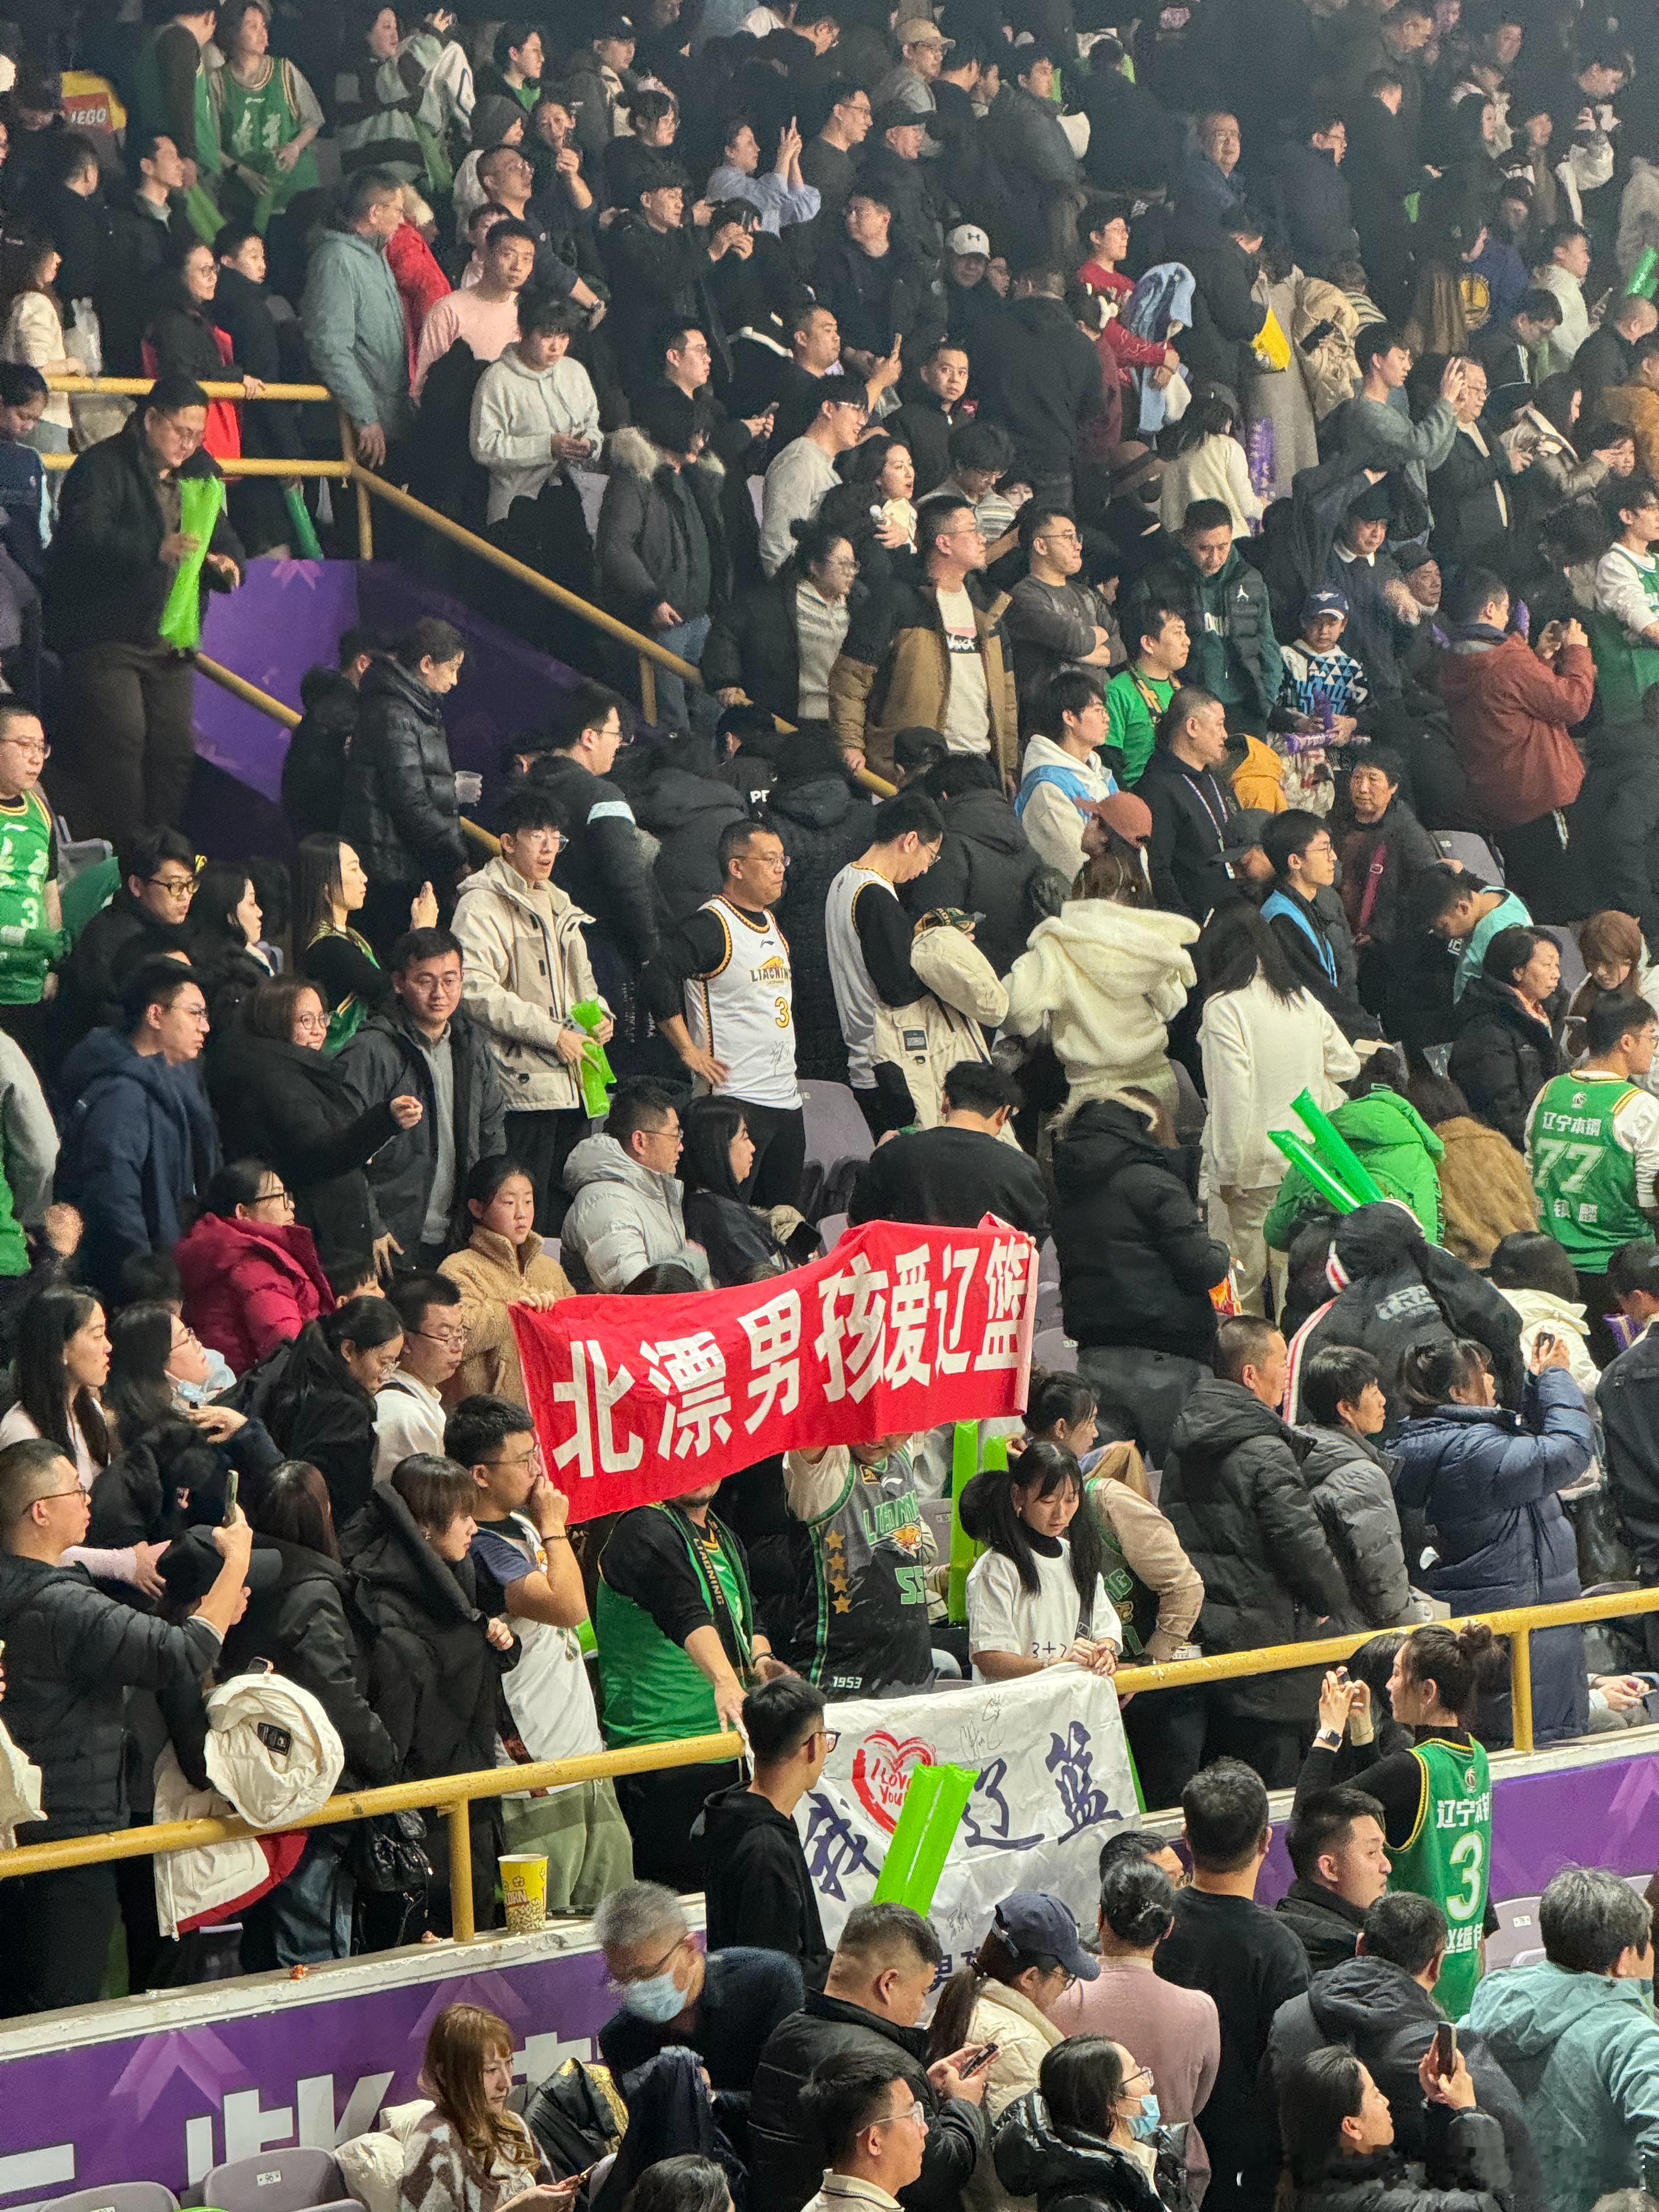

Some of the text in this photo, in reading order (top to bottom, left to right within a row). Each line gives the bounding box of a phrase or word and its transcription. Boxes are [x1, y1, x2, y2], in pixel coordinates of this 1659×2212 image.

[20, 898, 38, 930] 3
[775, 996, 789, 1028] 3
[1534, 1137, 1608, 1194] 77
[552, 1235, 1030, 1477] 北漂男孩爱辽篮
[693, 1538, 724, 1605] LIAONING
[833, 1676, 862, 1689] 1953
[1447, 1831, 1484, 1920] 3
